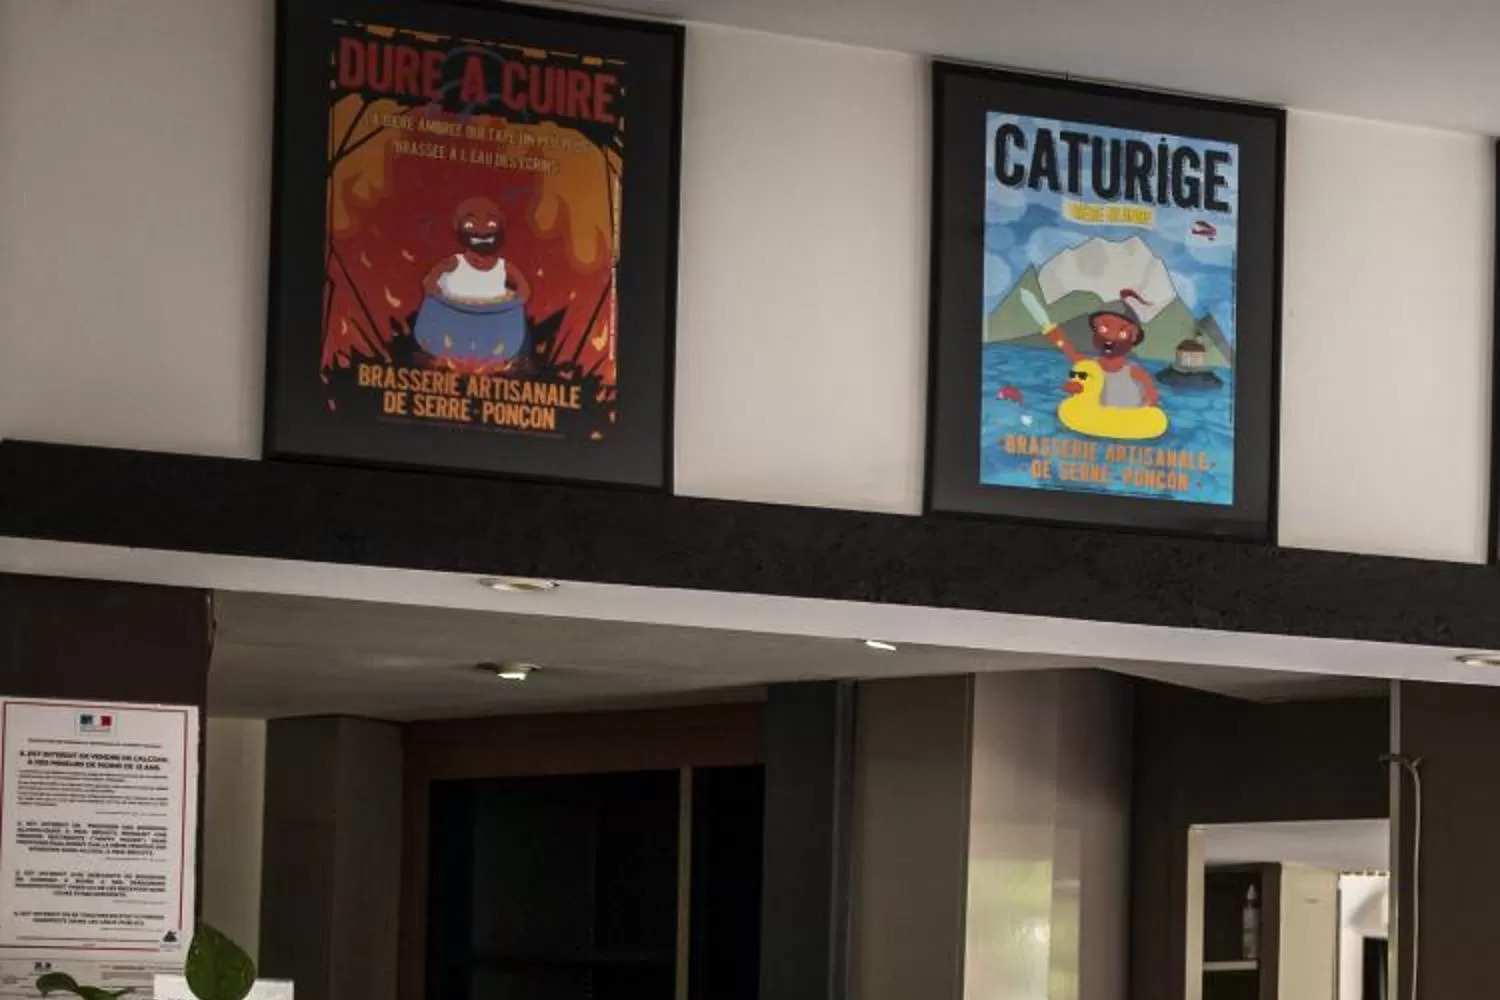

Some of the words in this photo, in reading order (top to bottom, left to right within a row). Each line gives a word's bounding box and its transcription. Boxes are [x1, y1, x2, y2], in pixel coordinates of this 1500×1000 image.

[339, 37, 447, 100] DURE
[503, 61, 619, 122] CUIRE
[358, 363, 461, 396] BRASSERIE
[466, 376, 582, 409] ARTISANALE
[383, 391, 408, 416] DE
